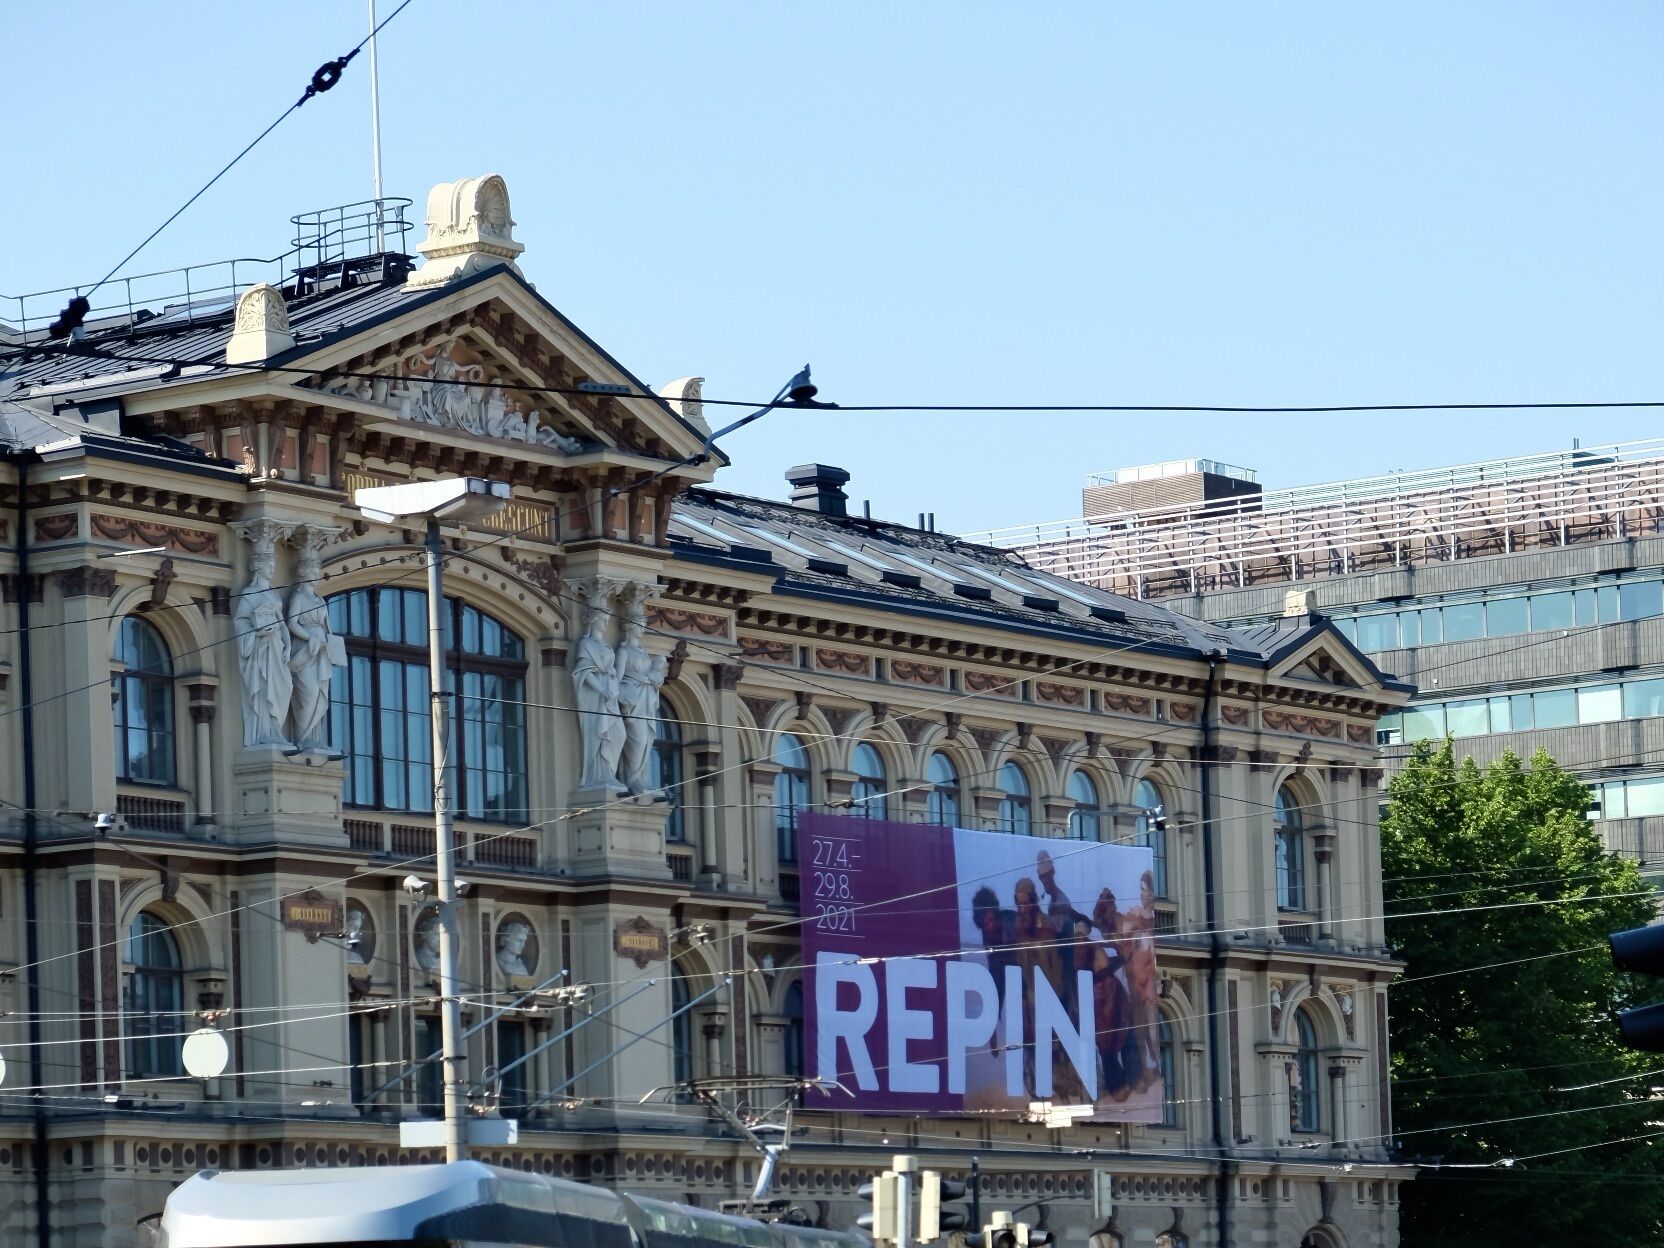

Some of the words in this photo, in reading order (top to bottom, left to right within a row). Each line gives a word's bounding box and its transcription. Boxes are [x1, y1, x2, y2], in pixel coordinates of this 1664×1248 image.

[814, 871, 854, 899] 29.8.
[816, 903, 856, 932] 2021
[815, 950, 1098, 1101] REPIN
